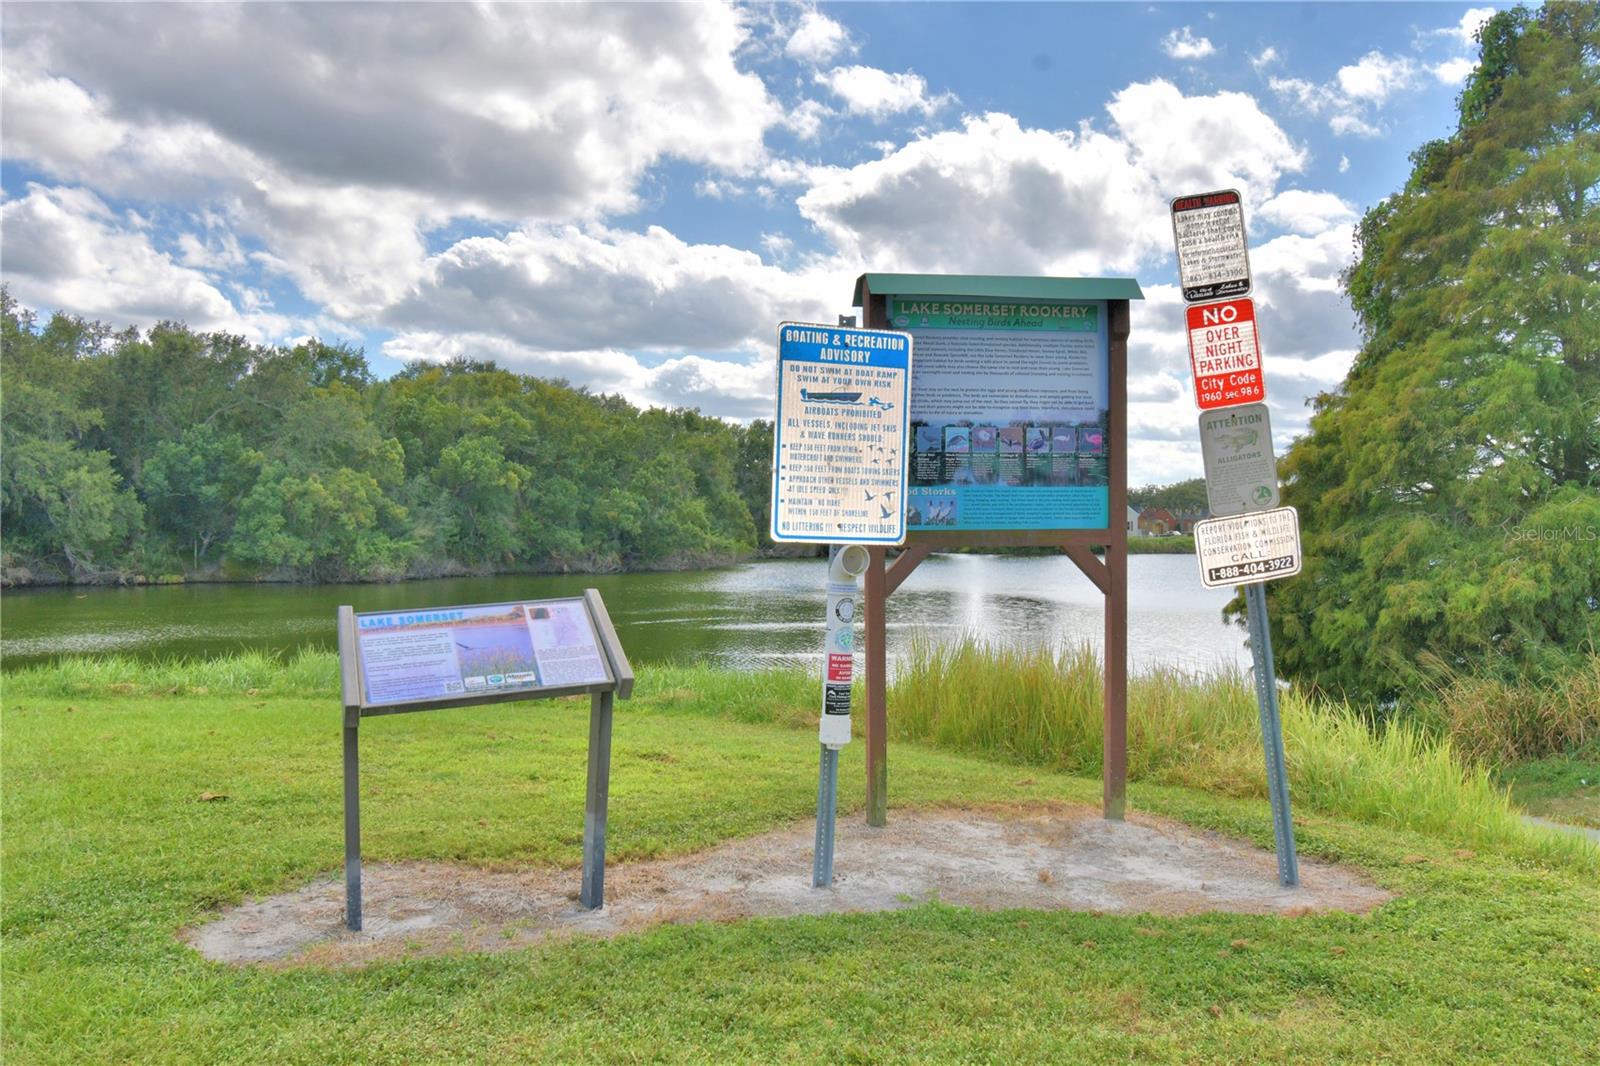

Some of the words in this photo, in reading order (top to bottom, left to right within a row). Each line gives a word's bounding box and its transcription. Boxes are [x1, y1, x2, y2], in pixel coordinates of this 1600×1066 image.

[901, 303, 939, 315] LAKE
[943, 304, 1016, 316] SOMERSET
[1020, 305, 1089, 318] ROOKERY
[1202, 305, 1237, 326] NO
[949, 316, 984, 328] Nesting
[987, 317, 1011, 328] Birds
[1013, 318, 1043, 328] Ahead
[786, 330, 829, 345] BOATING
[832, 335, 841, 345] &
[845, 334, 904, 350] RECREATION
[1206, 326, 1240, 343] OVER
[820, 348, 871, 363] ADVISORY
[1205, 340, 1243, 358] NIGHT
[1199, 353, 1253, 373] PARKING
[820, 366, 841, 375] SWIM
[856, 369, 874, 377] BOAT
[877, 370, 897, 379] RAMP
[797, 375, 818, 383] SWIM
[821, 376, 830, 384] AT
[833, 377, 852, 386] YOUR
[855, 379, 871, 387] OWN
[874, 380, 892, 388] RISK
[1201, 378, 1224, 391] City
[1229, 373, 1256, 386] Code
[1201, 391, 1222, 402] 1960
[804, 406, 839, 416] AIRBOATS
[841, 408, 882, 419] PROHIBITED
[787, 418, 800, 427] ALL
[835, 421, 868, 431] INCLUDING
[871, 423, 880, 432] JET
[883, 424, 897, 433] SKIS
[1206, 413, 1262, 431] ATTENTION
[808, 431, 825, 440] WAVE
[828, 432, 856, 441] RUNNERS
[1217, 451, 1262, 465] ALLIGATORS
[789, 464, 801, 472] KEEP
[815, 465, 826, 473] FEET
[836, 477, 858, 486] VESSELS
[921, 486, 957, 496] Storks
[782, 521, 790, 530] NO
[792, 522, 824, 532] LITTERING
[840, 523, 866, 533] RESPECT
[868, 523, 896, 534] WILDLIFE
[1201, 524, 1228, 535] REPORT
[1204, 533, 1232, 545] FLORIDA
[1235, 531, 1249, 541] FISH
[1203, 542, 1252, 557] CONSERVATION
[1255, 535, 1295, 549] COMMISSION
[1231, 550, 1268, 562] CALL
[1210, 557, 1292, 580] 1-888-404-3922
[360, 616, 393, 628] LAKE
[399, 612, 464, 625] SOMERSET
